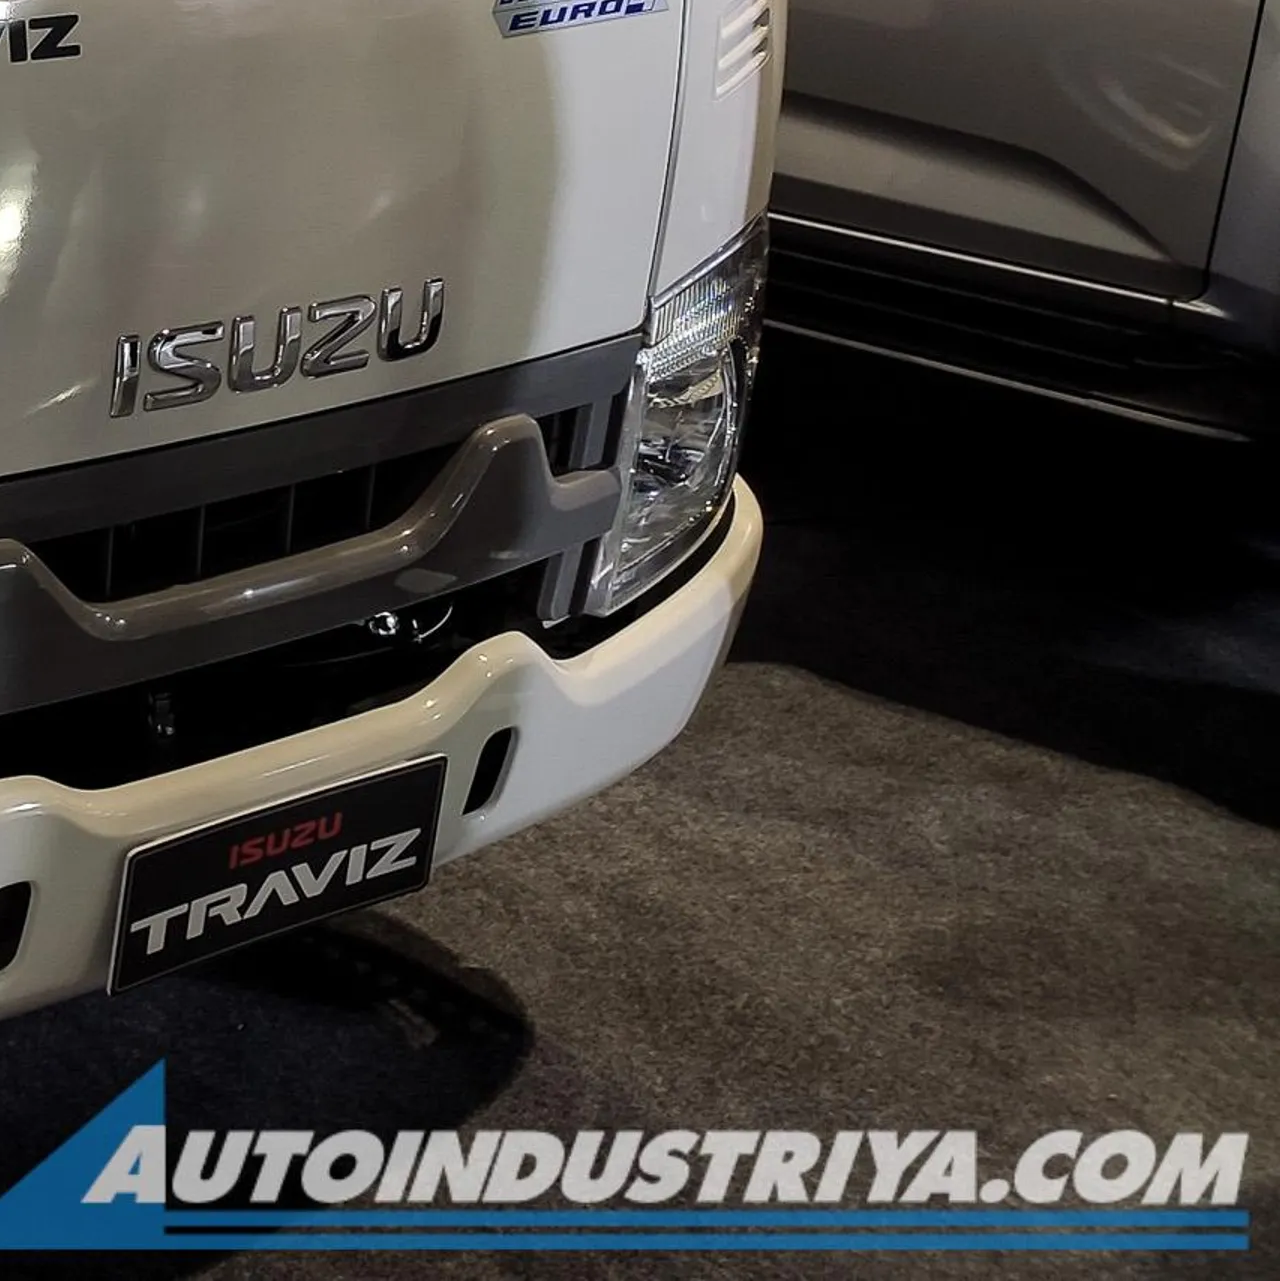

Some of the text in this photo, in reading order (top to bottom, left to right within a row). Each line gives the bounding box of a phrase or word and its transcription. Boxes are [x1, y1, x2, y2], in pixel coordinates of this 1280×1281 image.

[109, 277, 444, 419] ISUZU
[130, 827, 422, 956] TRAVIZ
[228, 812, 344, 870] ISUZU
